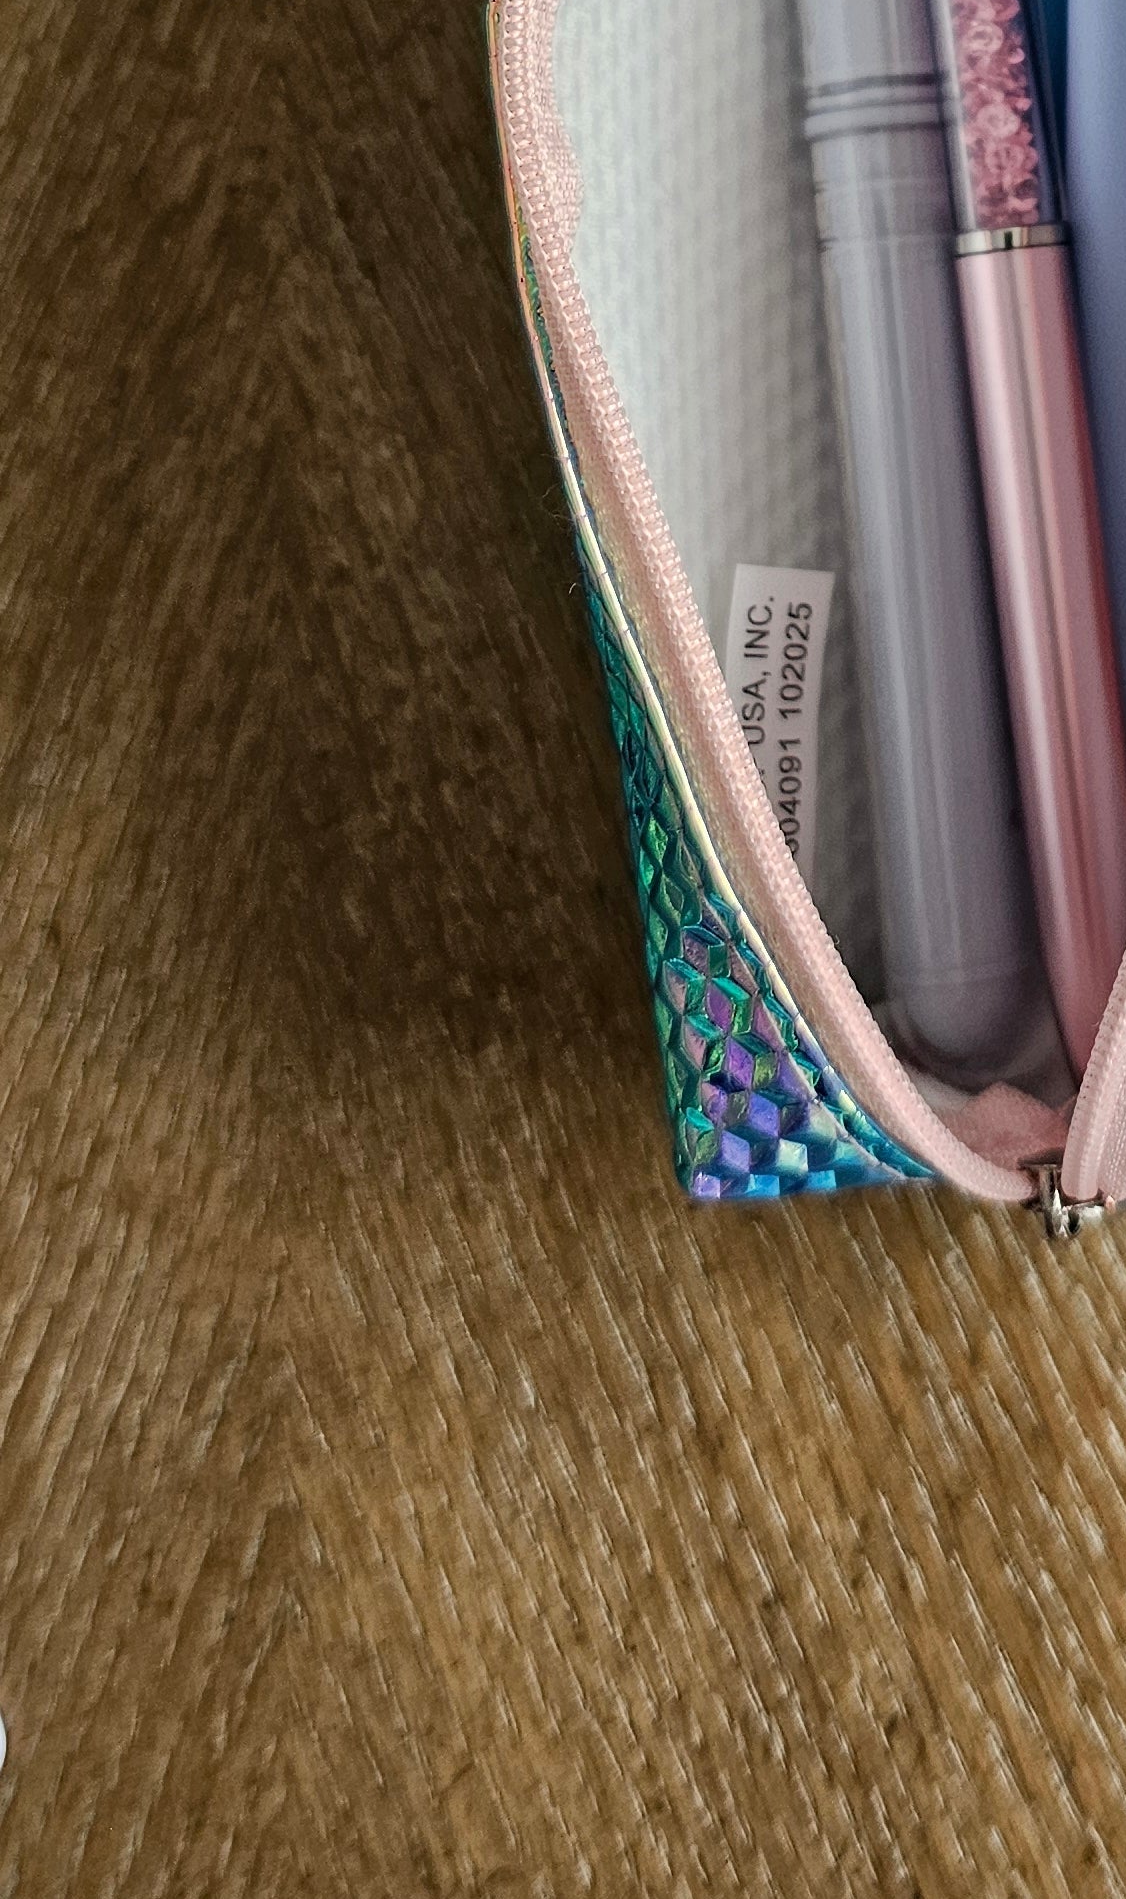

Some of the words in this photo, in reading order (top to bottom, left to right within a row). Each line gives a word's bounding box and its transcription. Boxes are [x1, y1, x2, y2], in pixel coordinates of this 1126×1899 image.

[744, 595, 775, 660] INC.
[778, 602, 813, 720] 102025
[741, 671, 771, 746] USA,
